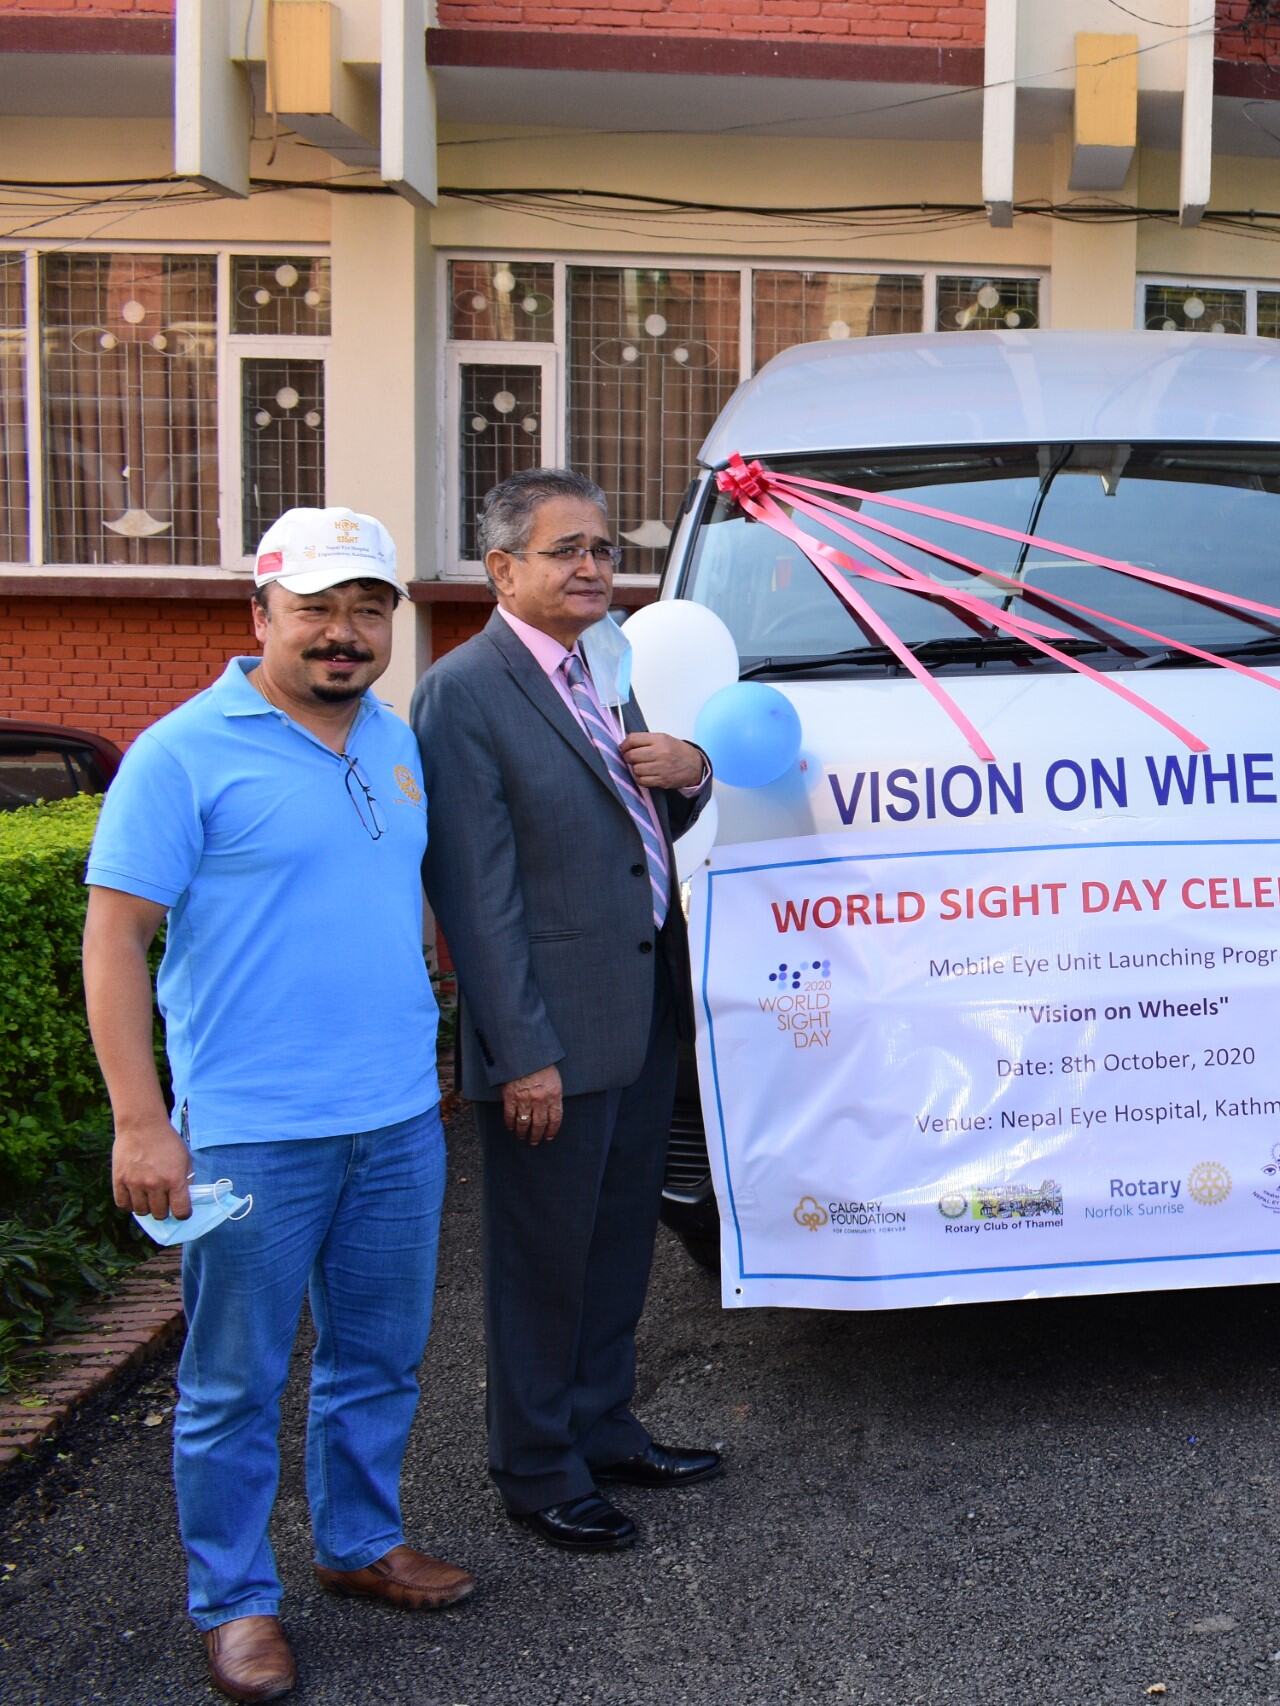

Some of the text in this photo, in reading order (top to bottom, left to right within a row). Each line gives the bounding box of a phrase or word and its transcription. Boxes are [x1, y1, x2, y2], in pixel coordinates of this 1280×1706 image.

[828, 763, 1024, 825] VISION
[1045, 757, 1127, 811] ON
[770, 891, 926, 934] WORLD
[939, 882, 1067, 921] SIGHT
[1081, 878, 1168, 914] DAY
[929, 955, 1009, 978] Mobile
[1012, 954, 1049, 978] Eye
[1057, 951, 1102, 972] Unit
[1109, 948, 1216, 970] Launching
[804, 980, 832, 992] 2020
[758, 993, 830, 1013] WORLD
[1018, 996, 1230, 1025] "Vision on Wheels"
[777, 1011, 831, 1031] SIGHT
[794, 1030, 832, 1049] DAY
[997, 1047, 1256, 1078] Date: 8th October, 2020
[917, 1113, 993, 1134] Venue:
[1001, 1107, 1063, 1131] Nepal
[1070, 1105, 1107, 1128] Eye
[1114, 1099, 1208, 1125] Hospital,
[1110, 1178, 1182, 1199] Rotary
[828, 1201, 883, 1214] CALGARY
[1085, 1202, 1185, 1219] Norfolk Sunrise
[831, 1212, 906, 1226] FOUNDATION
[945, 1219, 1064, 1234] Rotary Club of Thamel
